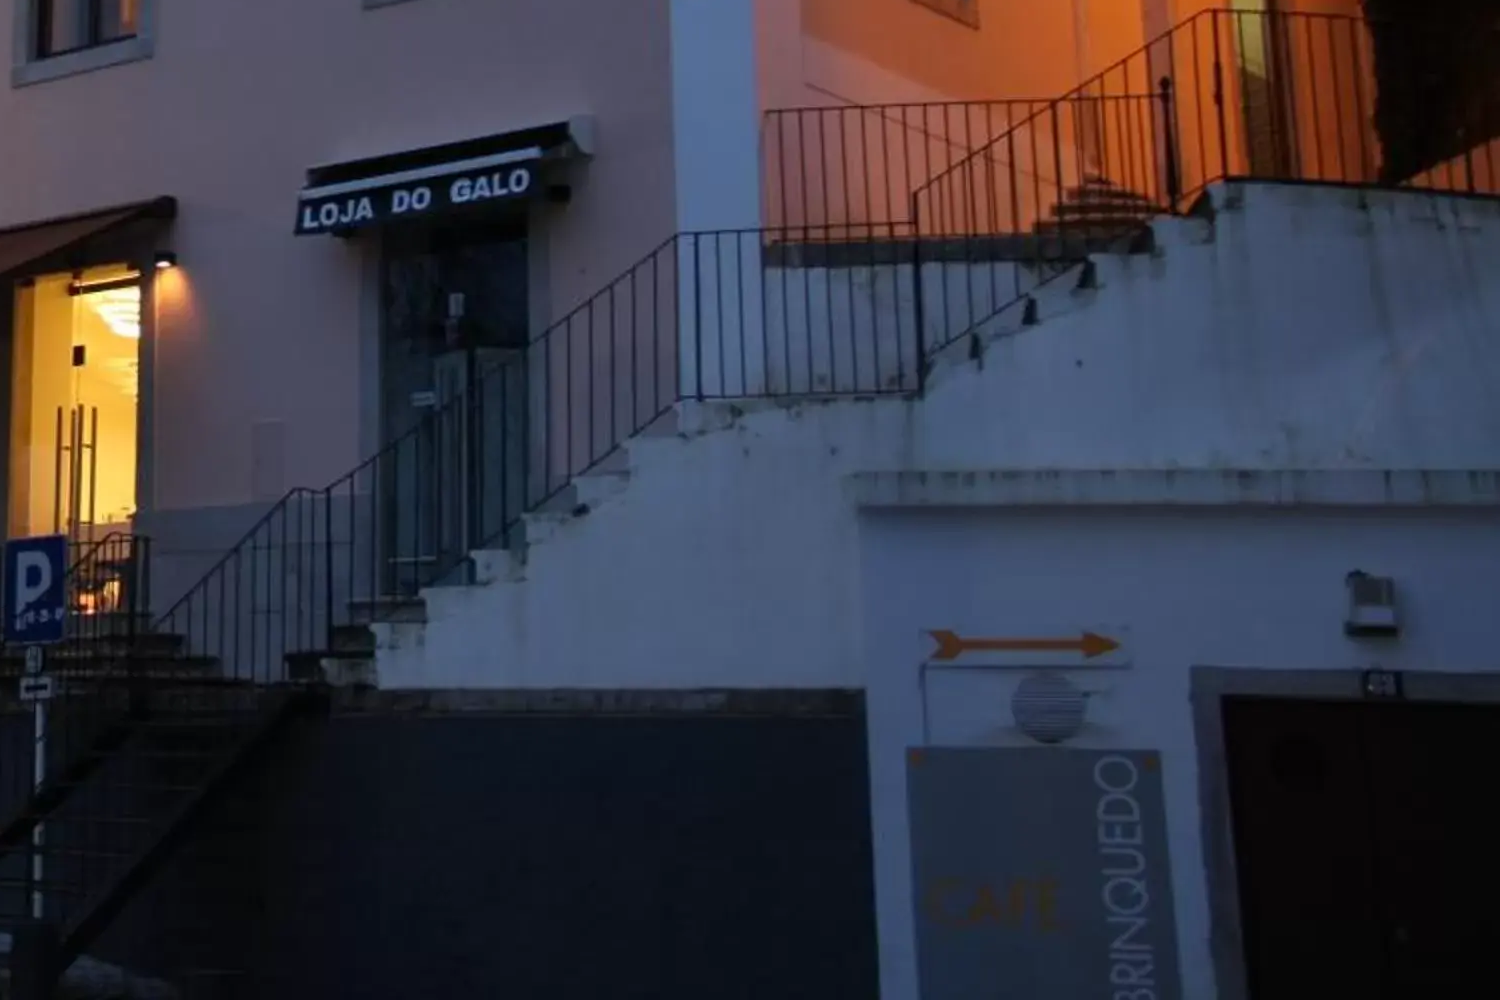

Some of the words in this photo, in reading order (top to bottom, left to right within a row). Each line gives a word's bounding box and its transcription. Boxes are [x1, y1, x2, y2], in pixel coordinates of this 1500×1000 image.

[302, 196, 374, 229] LOJA
[391, 186, 432, 214] DO
[450, 168, 531, 203] GALO
[15, 551, 52, 632] P
